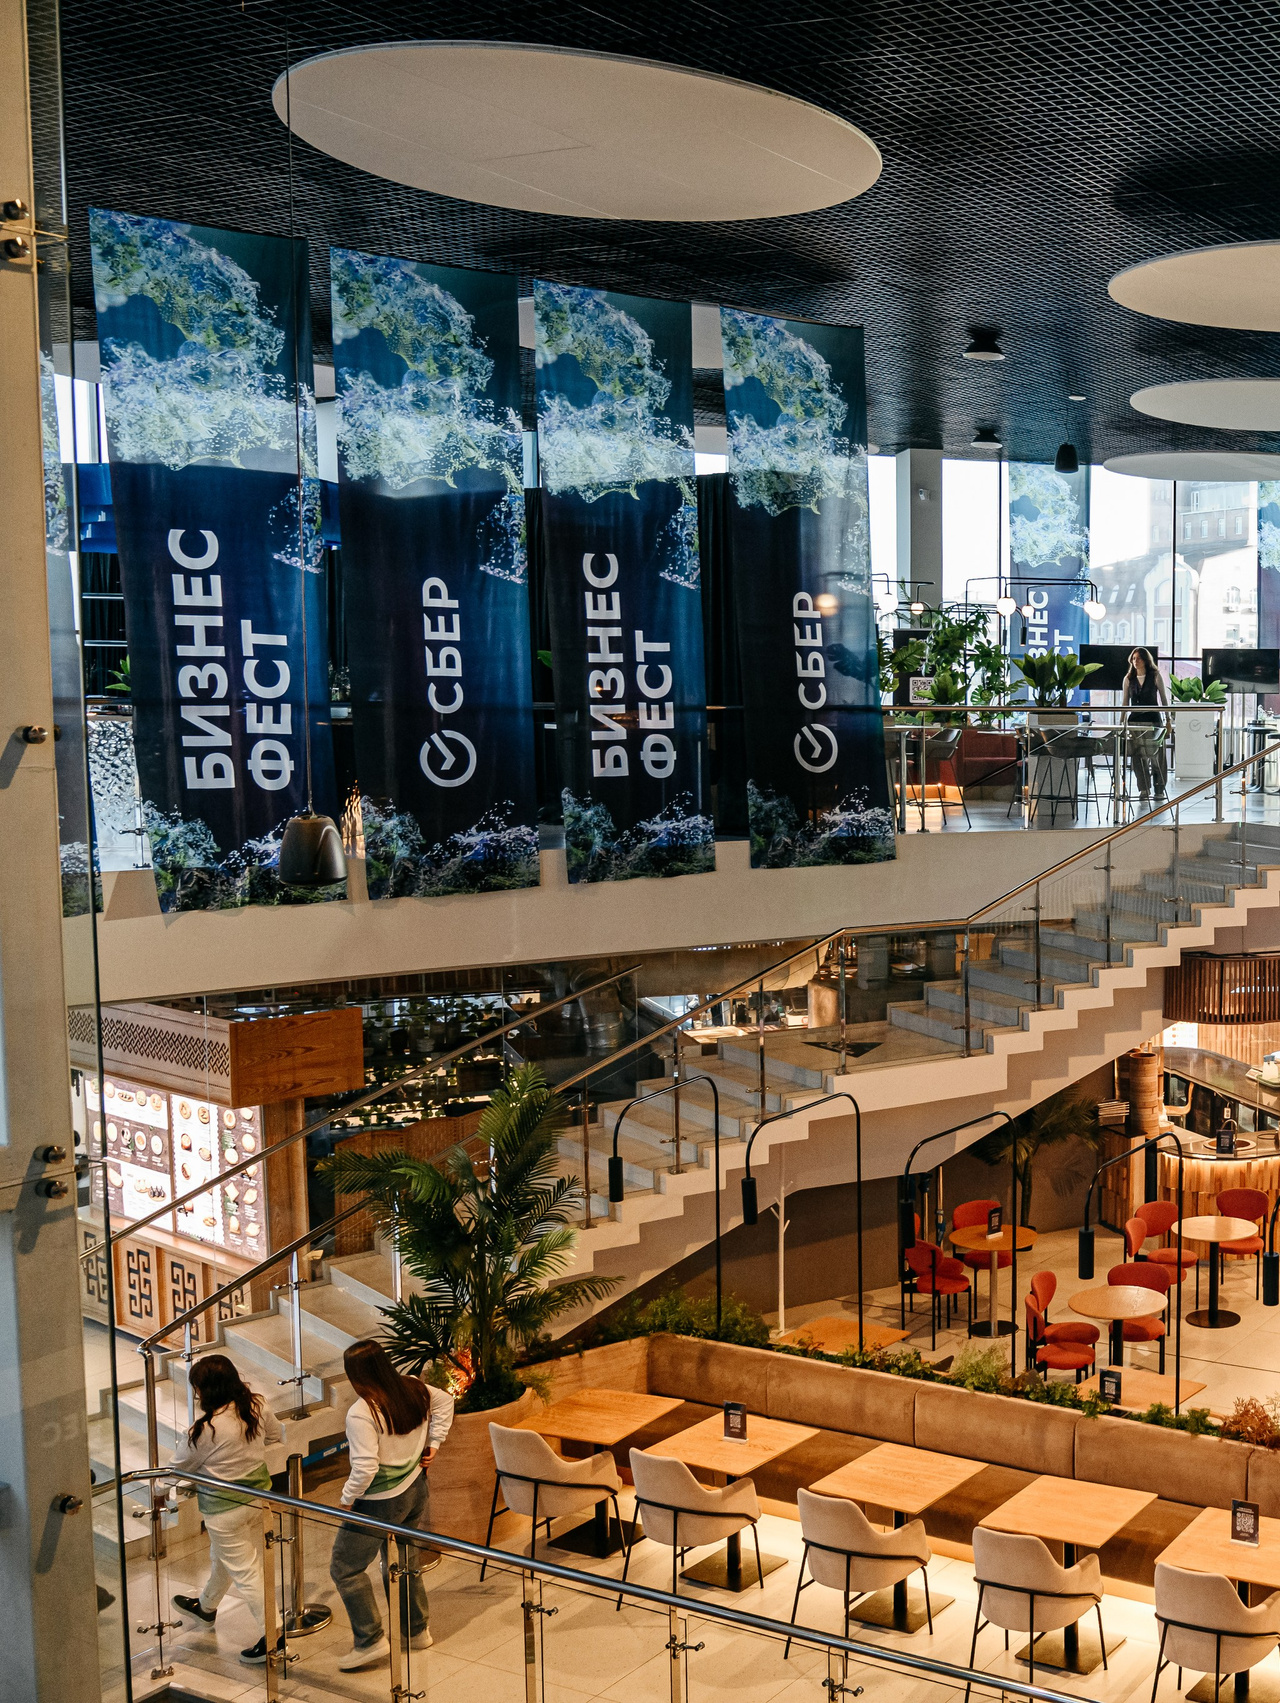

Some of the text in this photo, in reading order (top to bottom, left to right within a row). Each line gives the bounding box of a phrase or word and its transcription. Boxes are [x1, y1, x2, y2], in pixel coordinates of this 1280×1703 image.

[168, 528, 235, 789] БИЗНЕС
[241, 619, 294, 791] ФЕСТ
[422, 576, 464, 714] СБЕР
[583, 552, 629, 778] БИЗНЕС
[635, 630, 677, 779] ФЕСТ
[792, 591, 827, 710] СБЕР
